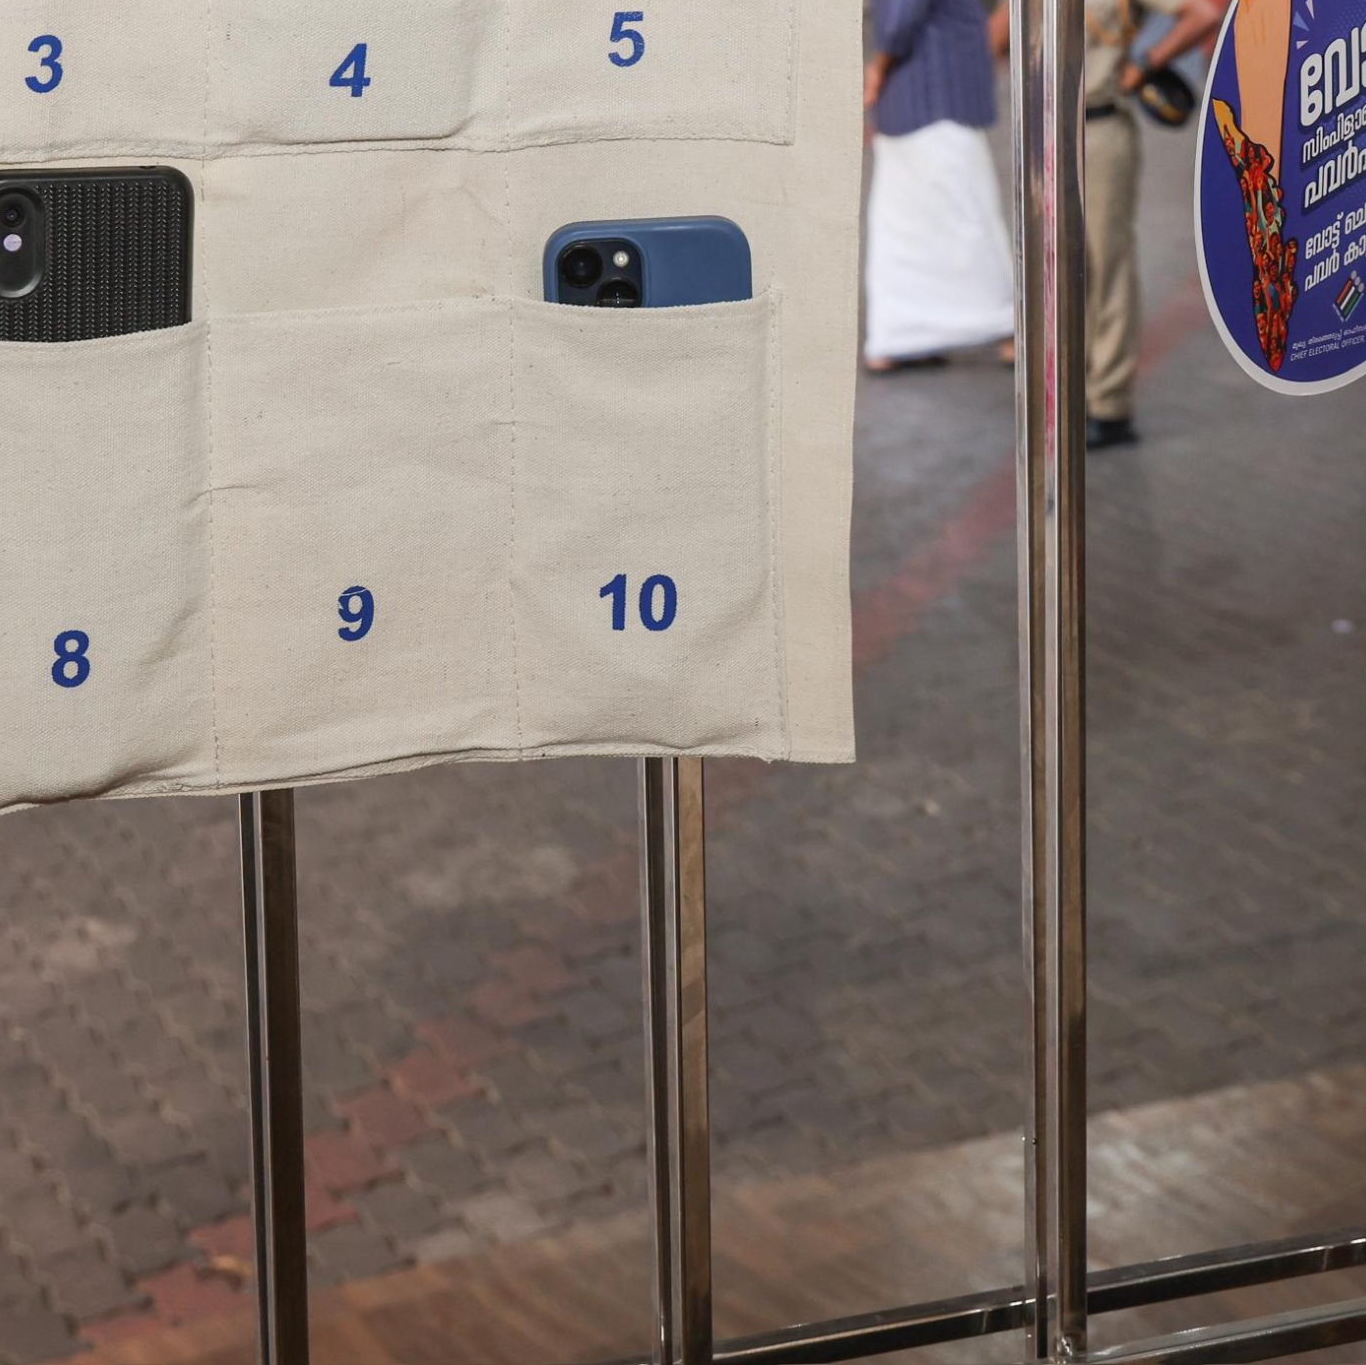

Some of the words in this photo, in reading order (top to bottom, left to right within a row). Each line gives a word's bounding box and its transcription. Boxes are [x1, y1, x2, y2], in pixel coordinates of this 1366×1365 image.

[26, 35, 63, 94] 3
[610, 11, 645, 67] 5
[329, 43, 371, 97] 4
[1305, 212, 1344, 259] വോട്ട്
[339, 586, 374, 641] 9
[600, 575, 677, 631] 10
[52, 630, 90, 687] 8
